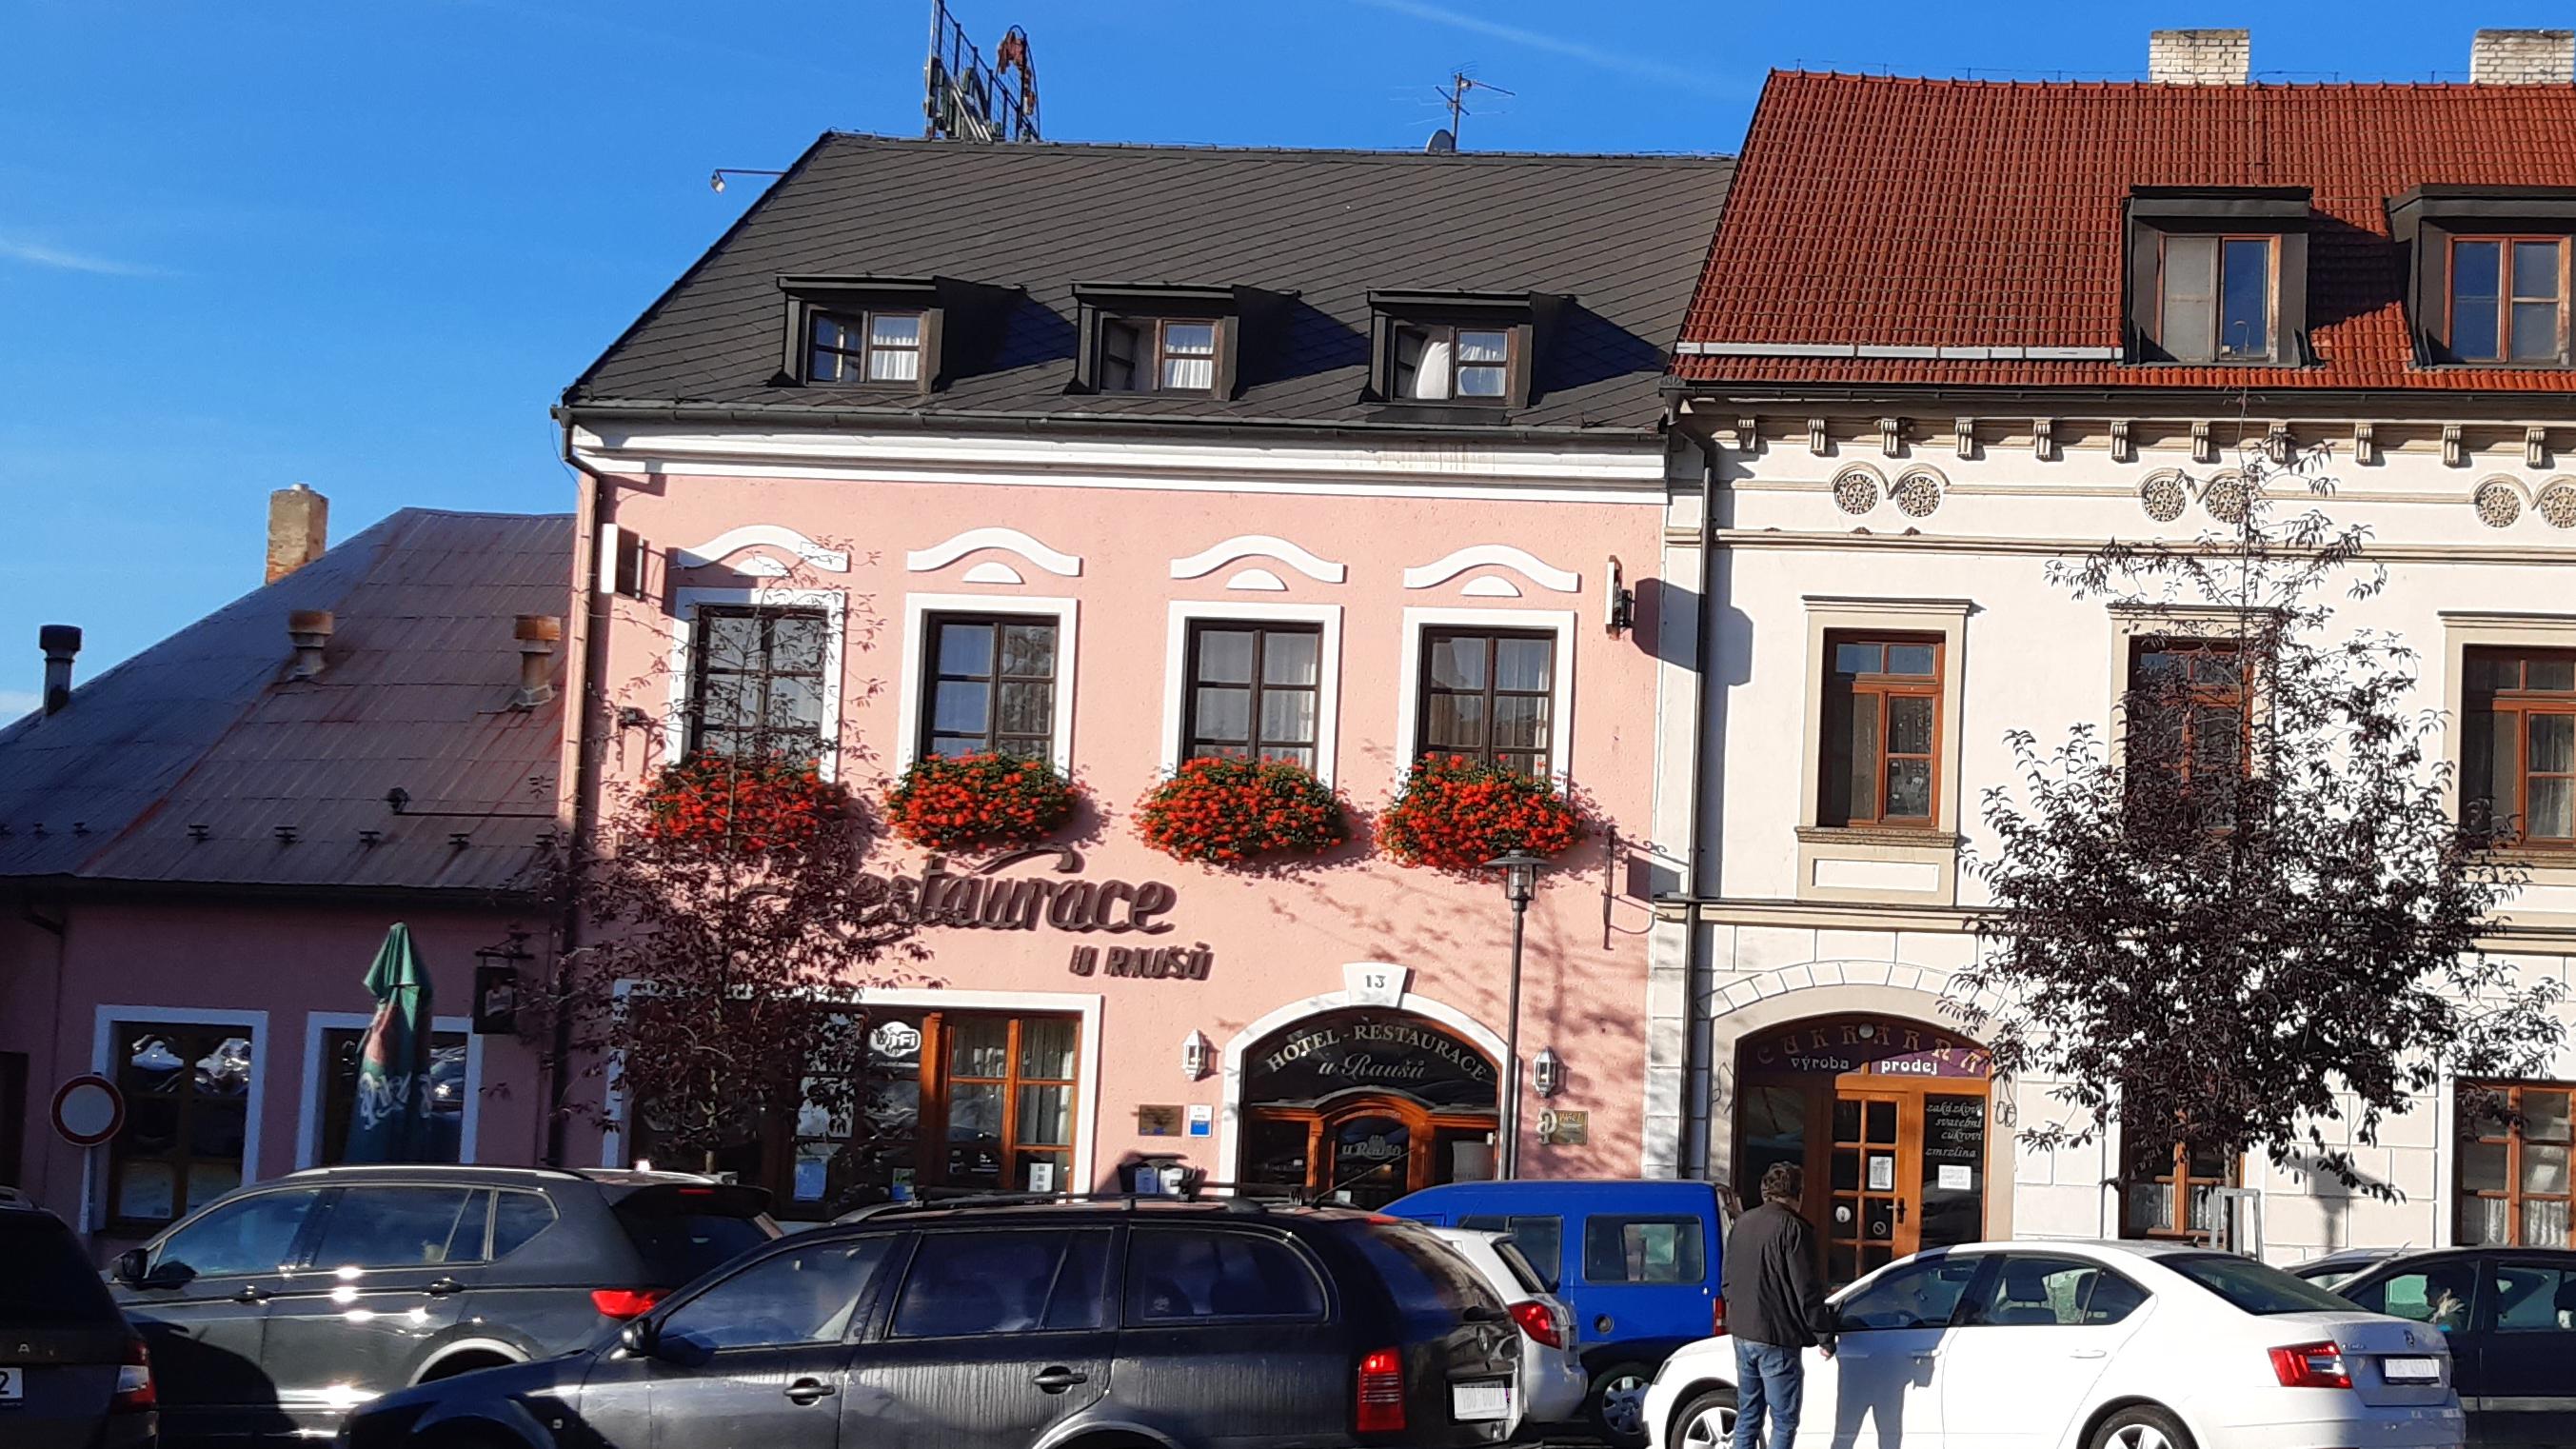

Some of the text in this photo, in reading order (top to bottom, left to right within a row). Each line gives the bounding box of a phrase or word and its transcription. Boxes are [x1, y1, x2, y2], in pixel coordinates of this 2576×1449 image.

[1365, 974, 1386, 988] 13
[1265, 1029, 1340, 1072] HOTEL
[1354, 1024, 1487, 1081] RESTAURACE
[1791, 1056, 1937, 1075] výroba prodej
[1925, 1145, 1976, 1158] zmrzlina
